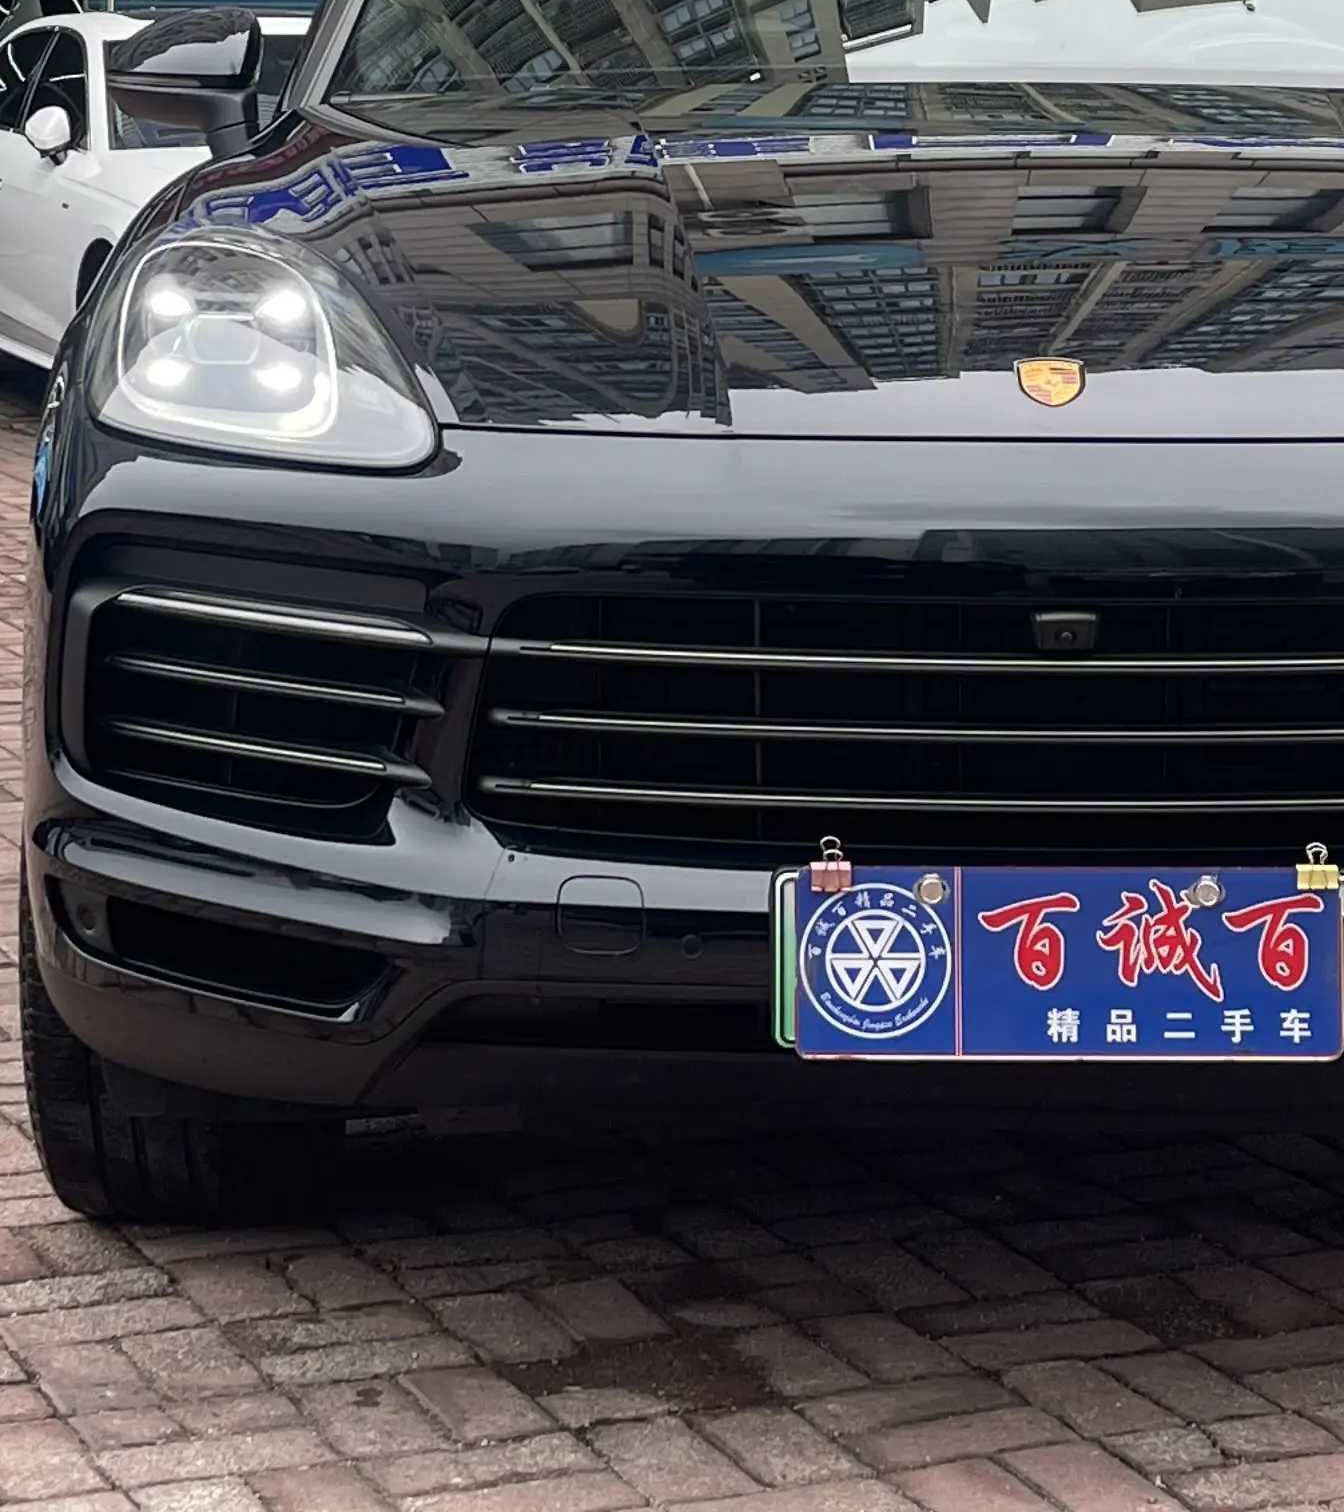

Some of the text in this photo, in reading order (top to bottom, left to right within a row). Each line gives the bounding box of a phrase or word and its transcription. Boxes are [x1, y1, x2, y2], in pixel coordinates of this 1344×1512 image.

[1046, 1007, 1313, 1044] 精品二手车
